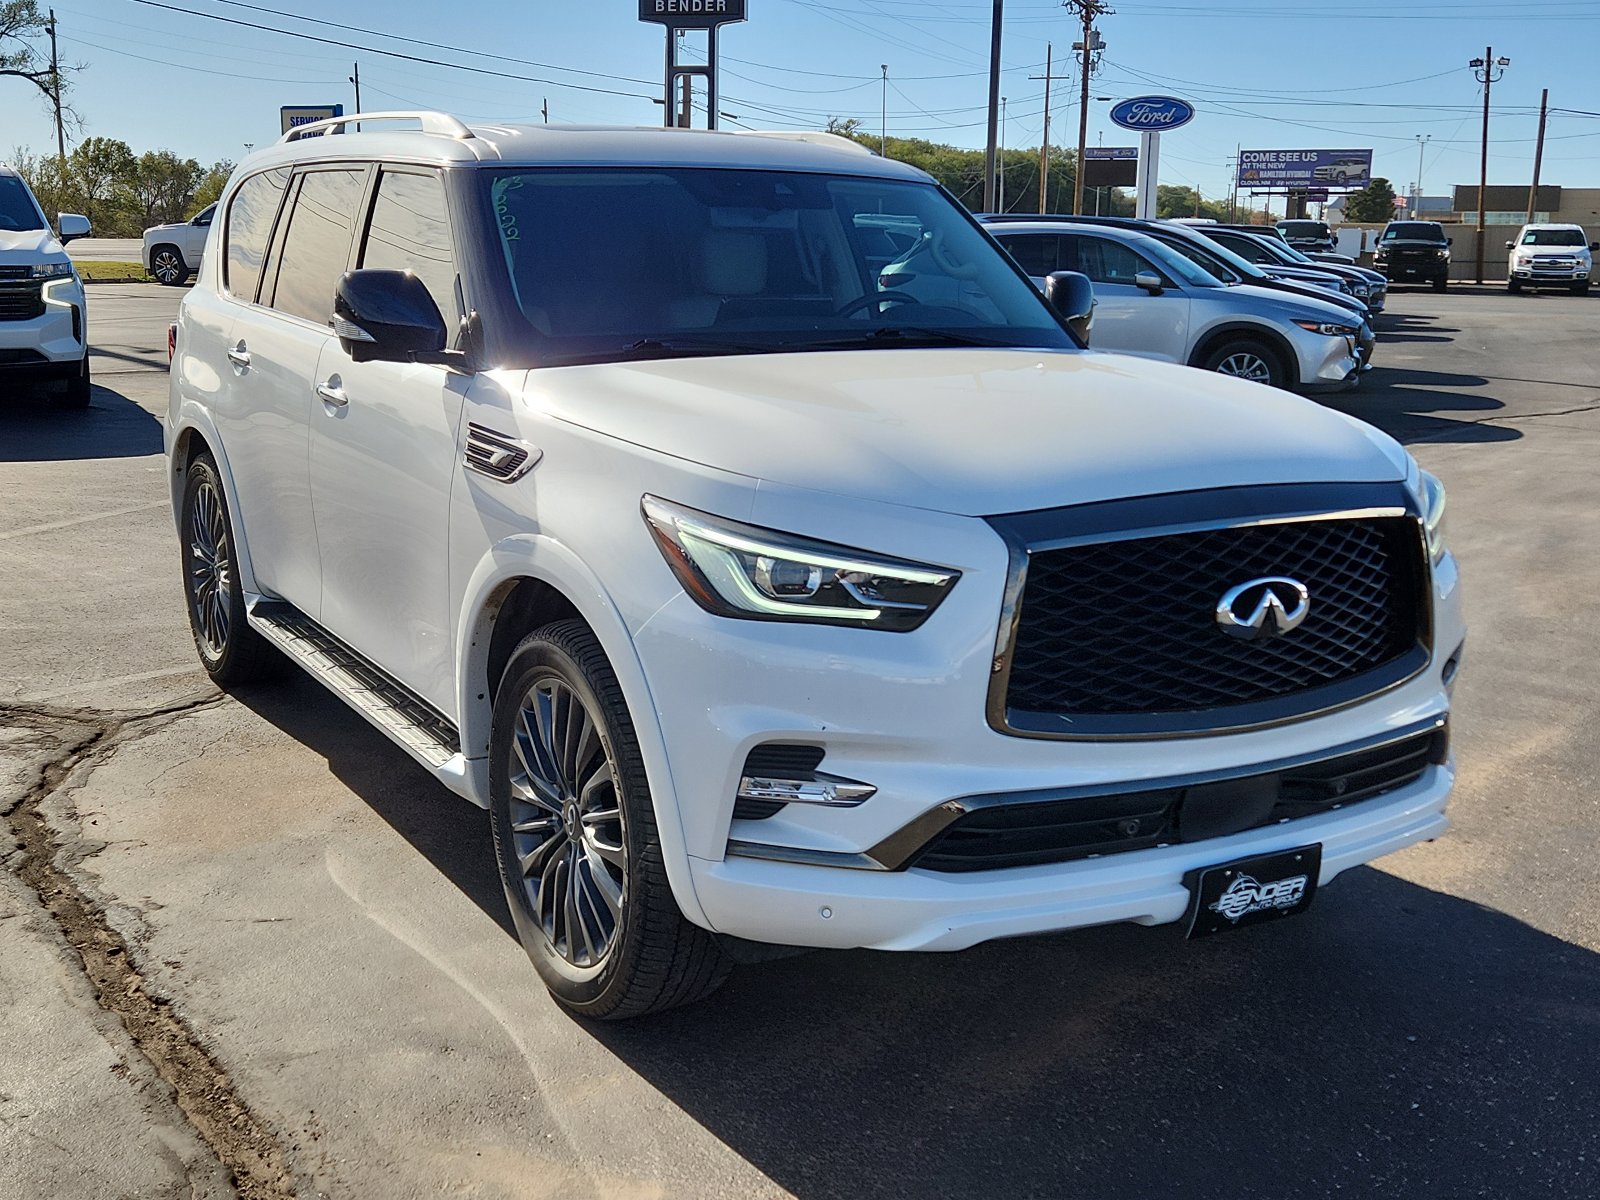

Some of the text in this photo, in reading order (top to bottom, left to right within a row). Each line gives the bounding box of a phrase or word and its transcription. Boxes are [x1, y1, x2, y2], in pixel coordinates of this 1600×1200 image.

[655, 0, 727, 12] BENDER
[1126, 102, 1177, 124] Ford
[1242, 152, 1318, 162] COME SEE US
[1259, 170, 1286, 178] HAMILTON
[1217, 877, 1307, 911] BENDER
